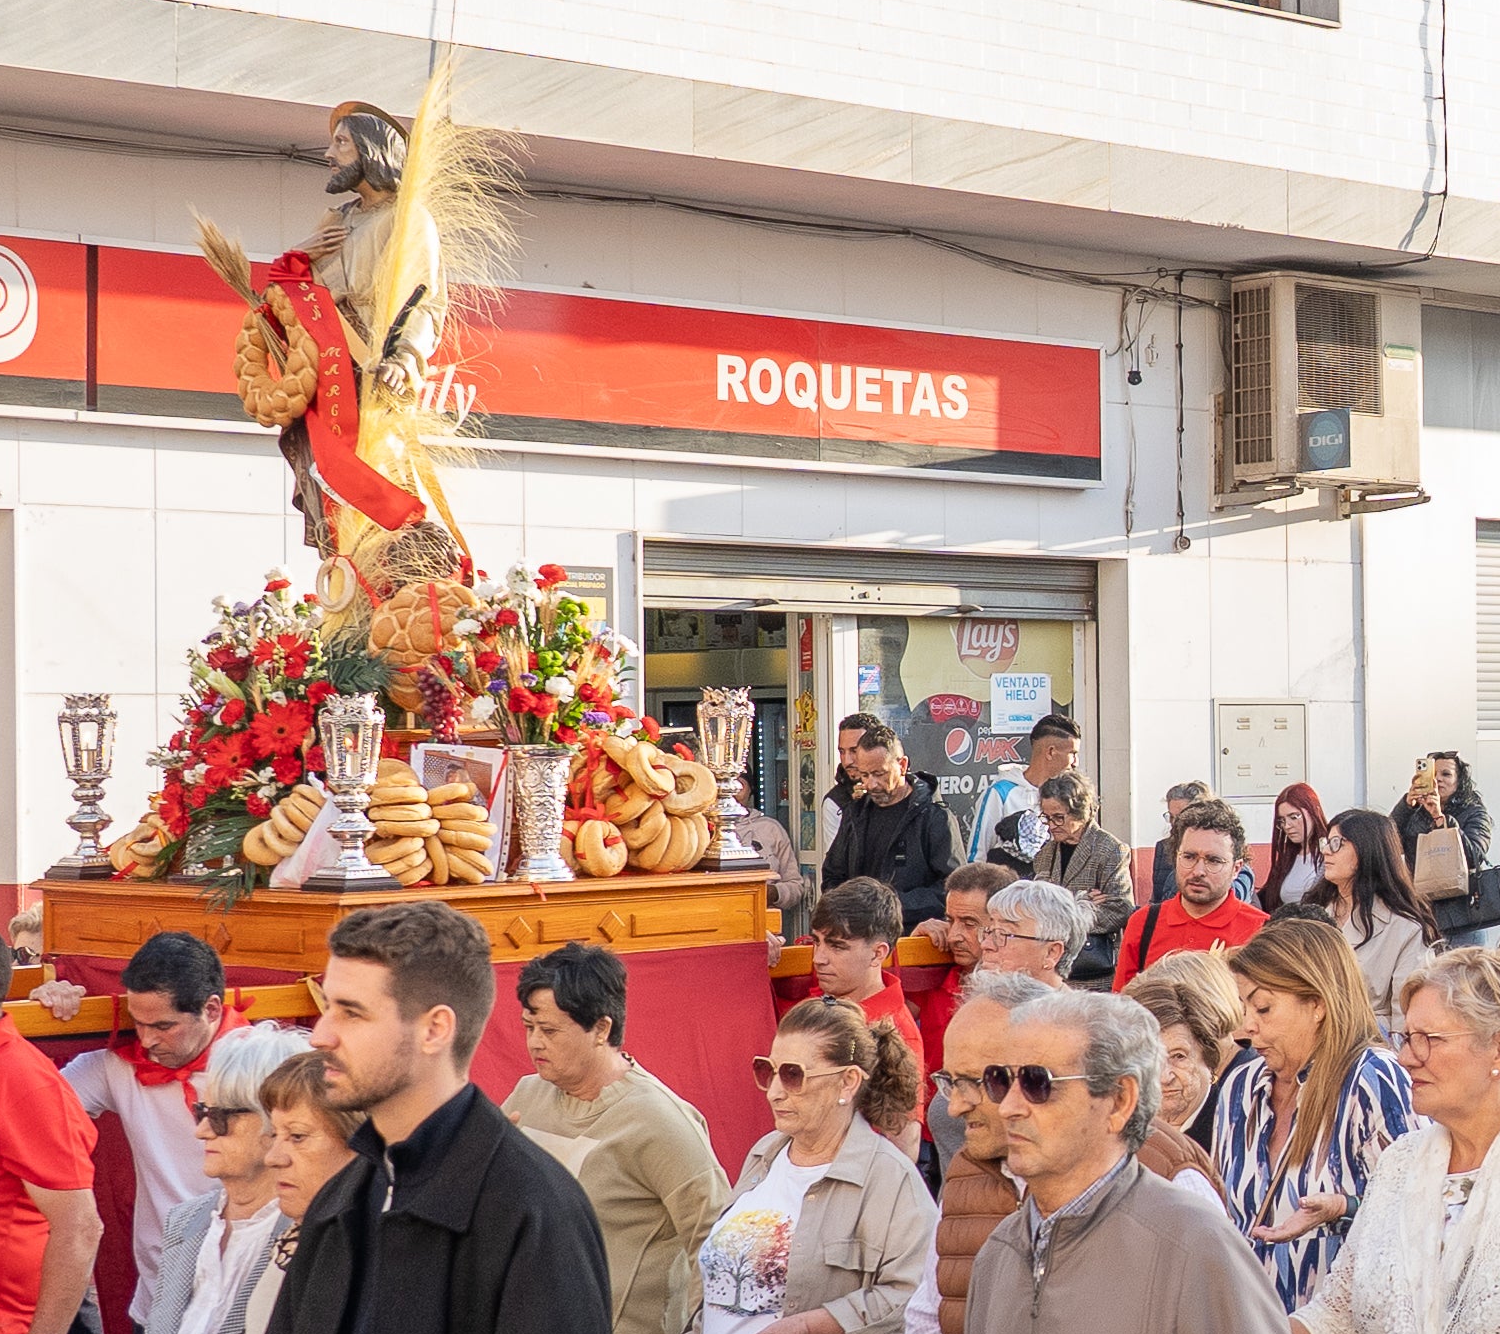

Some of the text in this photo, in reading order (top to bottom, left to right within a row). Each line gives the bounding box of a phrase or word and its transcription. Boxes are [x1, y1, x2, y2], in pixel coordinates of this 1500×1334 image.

[716, 353, 969, 420] ROQUETAS
[418, 364, 477, 435] ily
[1308, 433, 1343, 447] DIGI
[960, 619, 1018, 662] Lay's
[995, 676, 1047, 688] VENTA DE
[1005, 689, 1037, 701] HIELO
[977, 727, 991, 735] pep
[974, 736, 1024, 764] MAX
